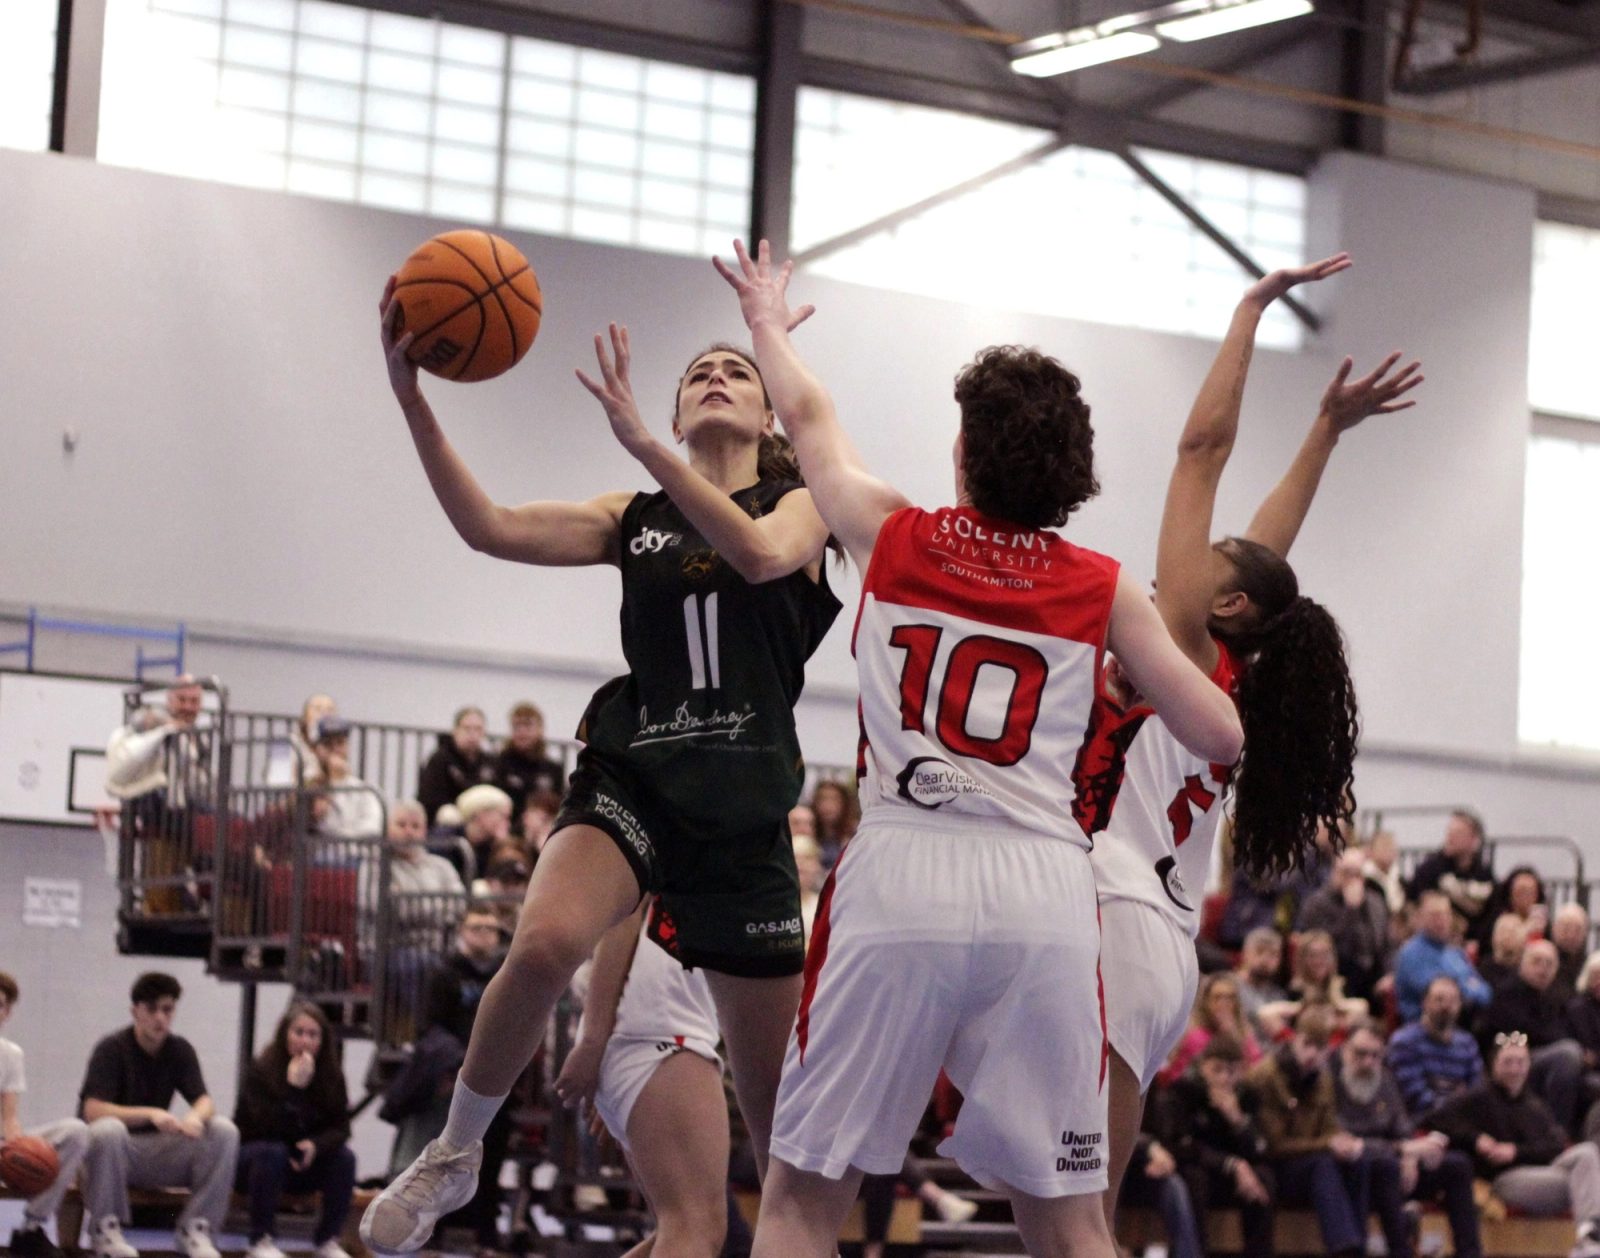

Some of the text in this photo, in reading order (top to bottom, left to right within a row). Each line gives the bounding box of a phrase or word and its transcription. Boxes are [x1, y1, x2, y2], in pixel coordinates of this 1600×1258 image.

[931, 532, 1051, 571] UNIVERSITY
[941, 562, 1033, 589] SOUTHAMPTON
[684, 592, 720, 689] 11
[889, 624, 1049, 766] 10
[914, 785, 960, 795] FINANCIAL
[1061, 1131, 1102, 1146] UNITED
[1071, 1147, 1095, 1159] NOT
[1056, 1157, 1101, 1172] DIVIDED
